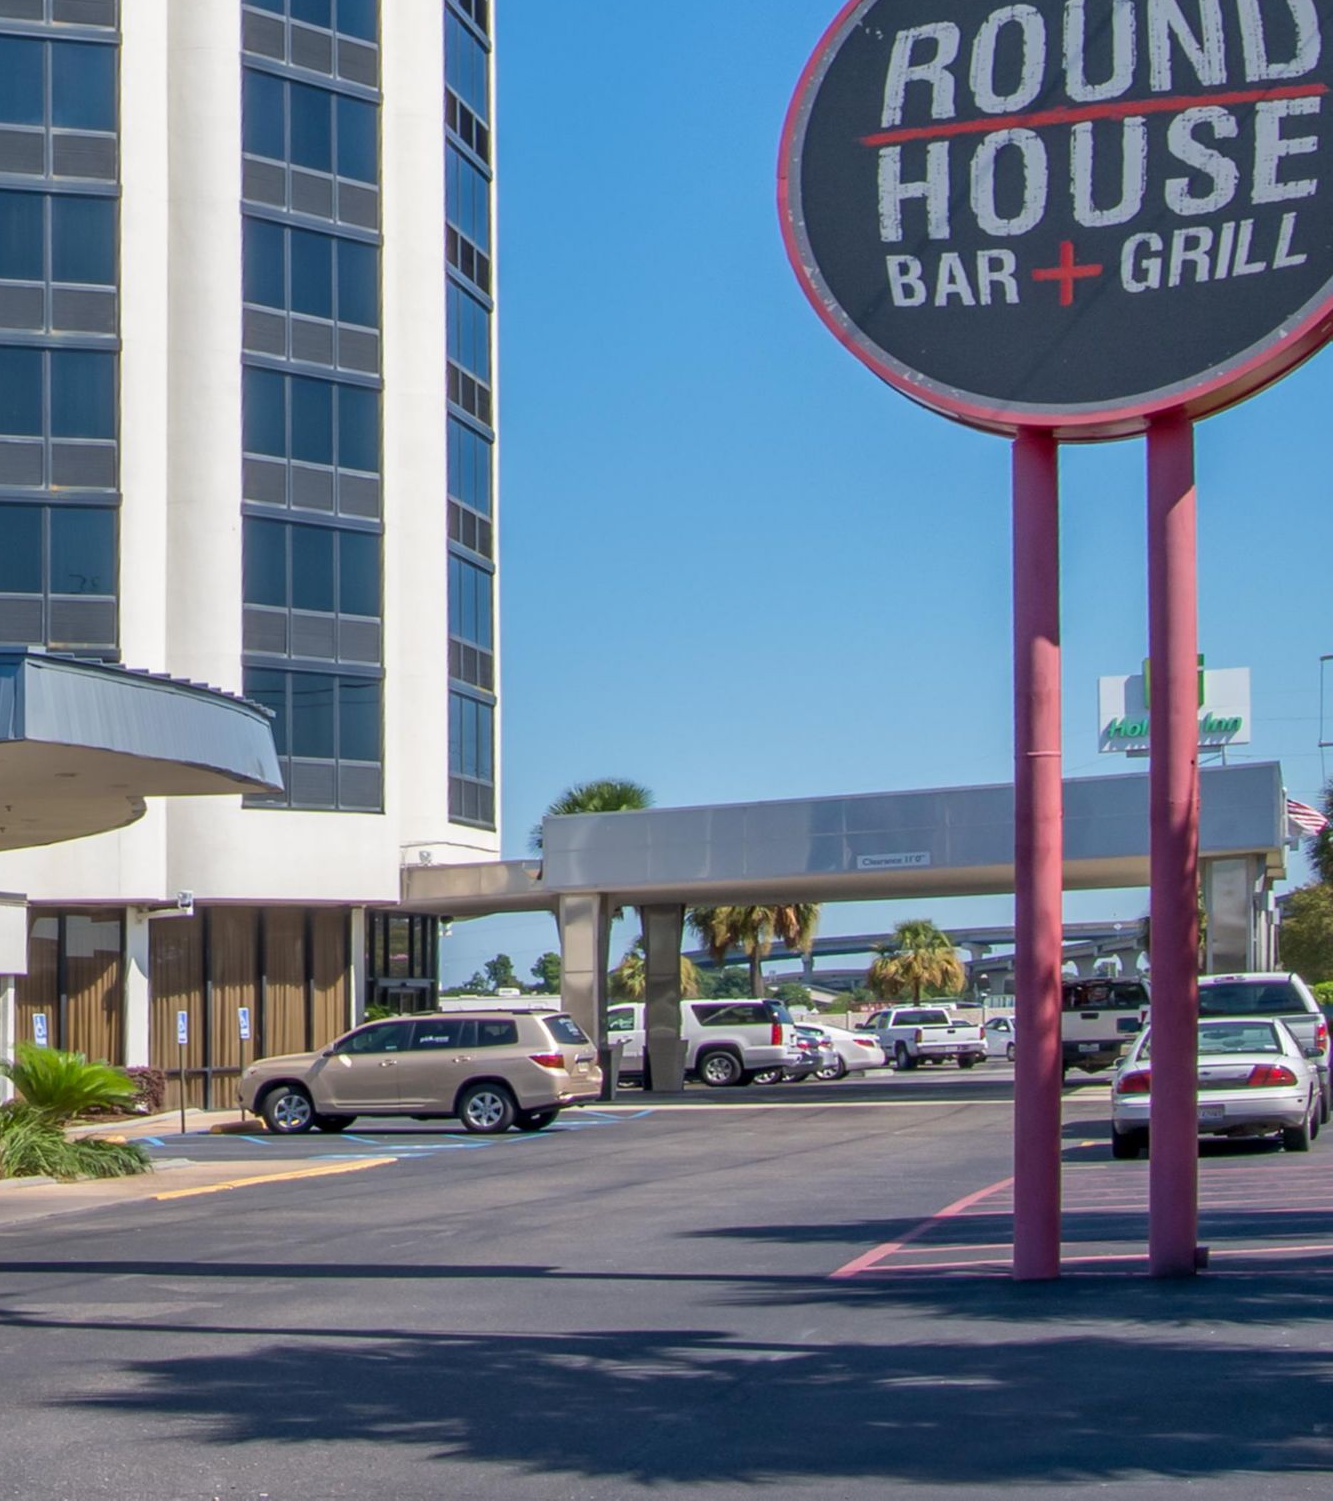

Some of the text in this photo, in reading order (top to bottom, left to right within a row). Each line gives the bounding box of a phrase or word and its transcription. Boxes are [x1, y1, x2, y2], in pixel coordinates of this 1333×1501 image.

[877, 96, 1322, 243] HOUSE
[886, 248, 1019, 307] BAR
[1120, 212, 1307, 292] GRILL
[1204, 710, 1242, 732] Inn
